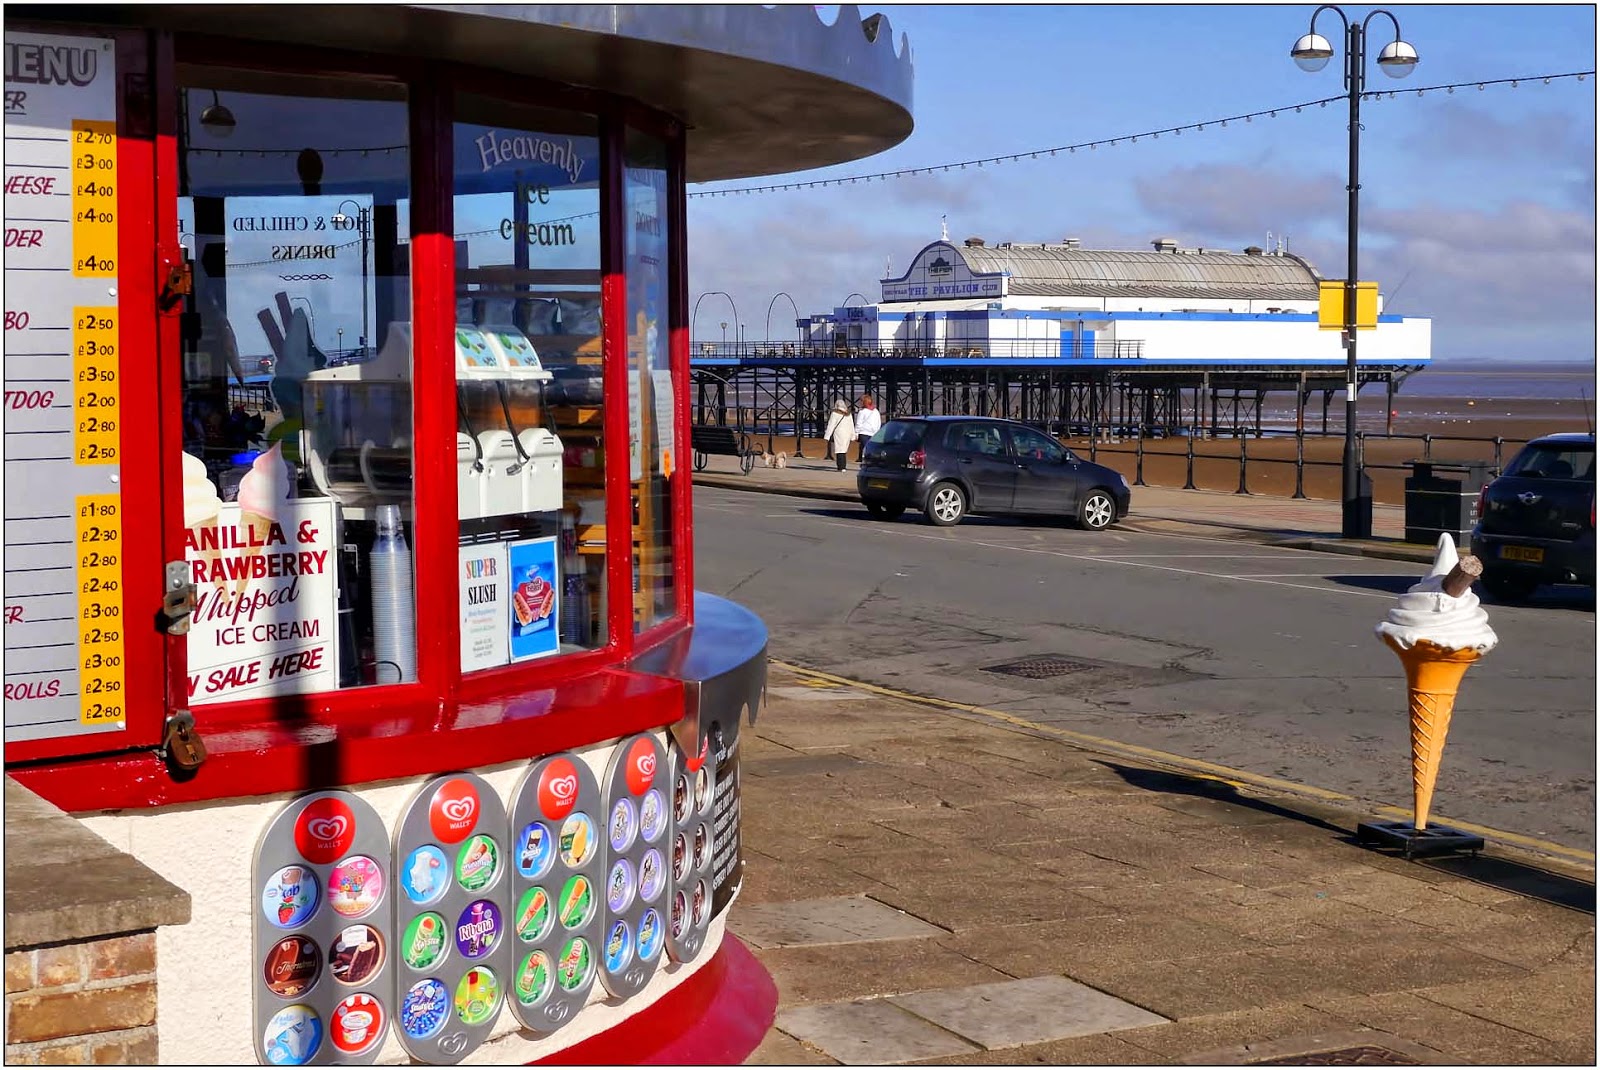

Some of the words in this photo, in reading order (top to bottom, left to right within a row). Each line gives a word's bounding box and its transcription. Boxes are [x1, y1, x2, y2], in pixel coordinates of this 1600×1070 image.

[475, 130, 585, 184] Heavenly
[909, 286, 928, 296] THE
[933, 284, 979, 296] PAVILION
[5, 311, 29, 330] BO
[297, 520, 319, 544] &
[188, 550, 329, 584] RAWBERRY
[466, 558, 497, 579] SUPER
[468, 584, 497, 606] SLUSH
[216, 627, 246, 647] ICE
[252, 619, 320, 642] CREAM
[205, 660, 261, 693] SALE
[269, 647, 324, 680] HERE
[458, 917, 494, 942] Ribena
